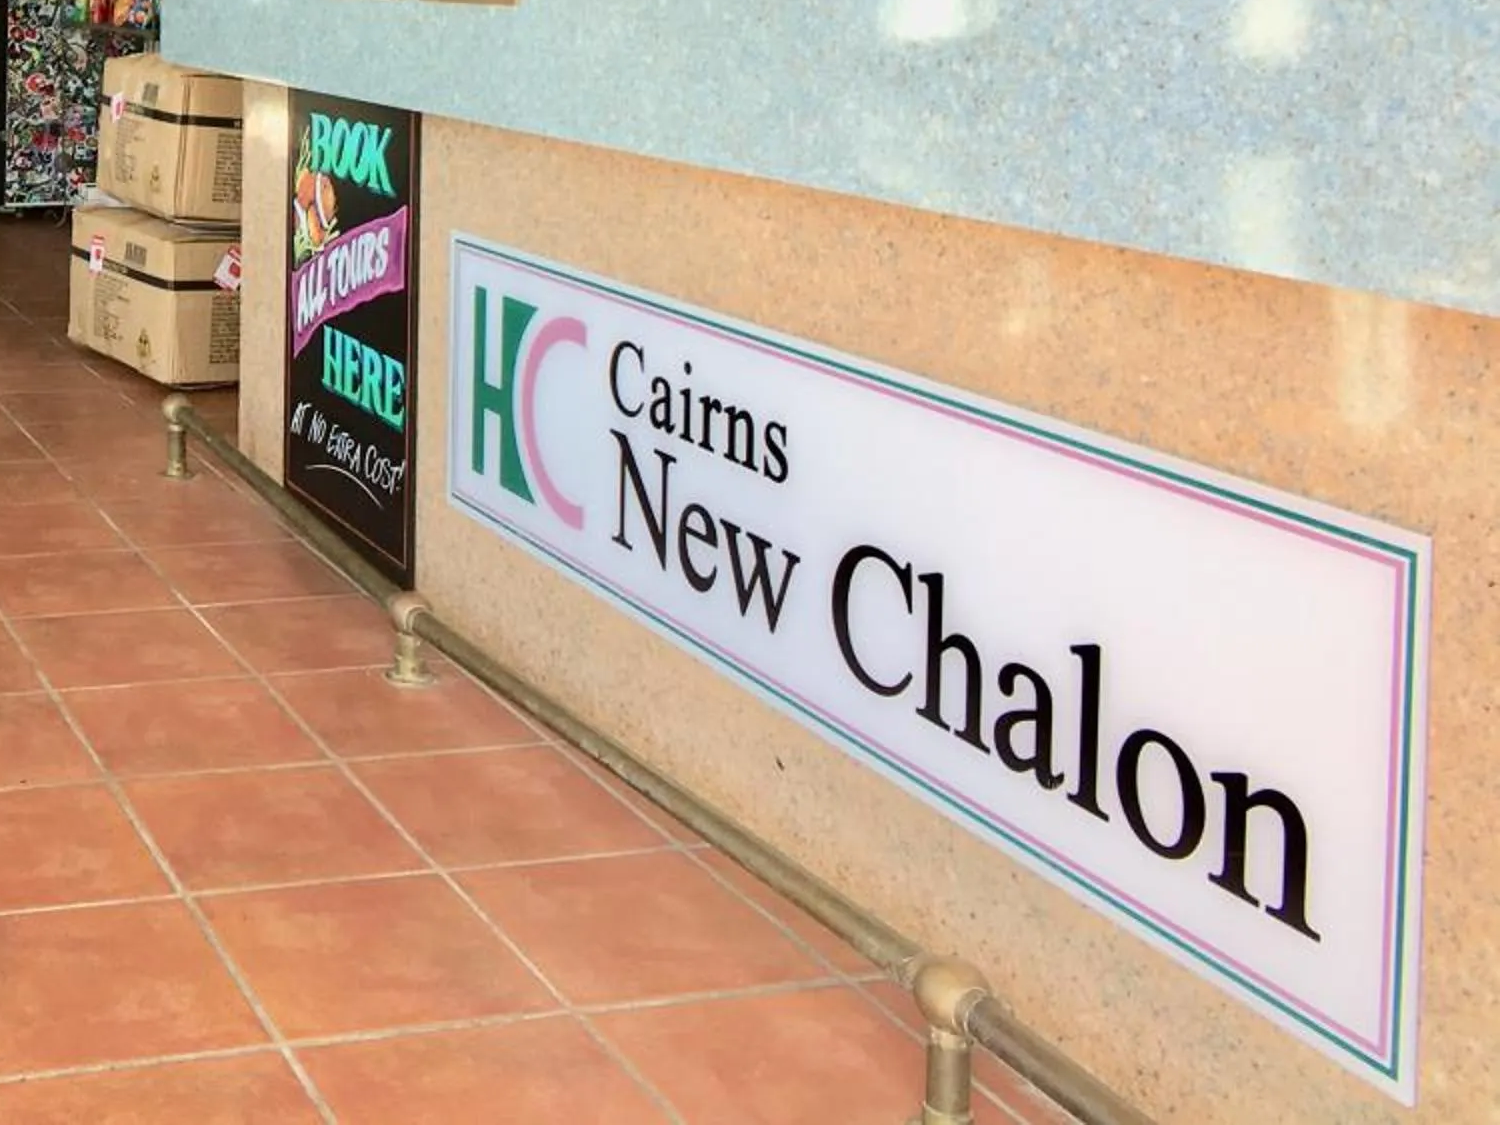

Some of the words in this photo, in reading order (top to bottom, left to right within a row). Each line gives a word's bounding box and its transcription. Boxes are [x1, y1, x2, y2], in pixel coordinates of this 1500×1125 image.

[309, 112, 396, 198] BOOK
[297, 254, 327, 332] ALL
[328, 226, 389, 306] TOURS
[321, 324, 405, 435] HERE
[608, 339, 789, 484] Cairns
[291, 401, 312, 435] AT
[308, 410, 327, 444] NO
[327, 424, 361, 474] EXTRA
[365, 444, 406, 495] COST!
[609, 428, 801, 634] New
[831, 543, 1322, 943] Chalon
